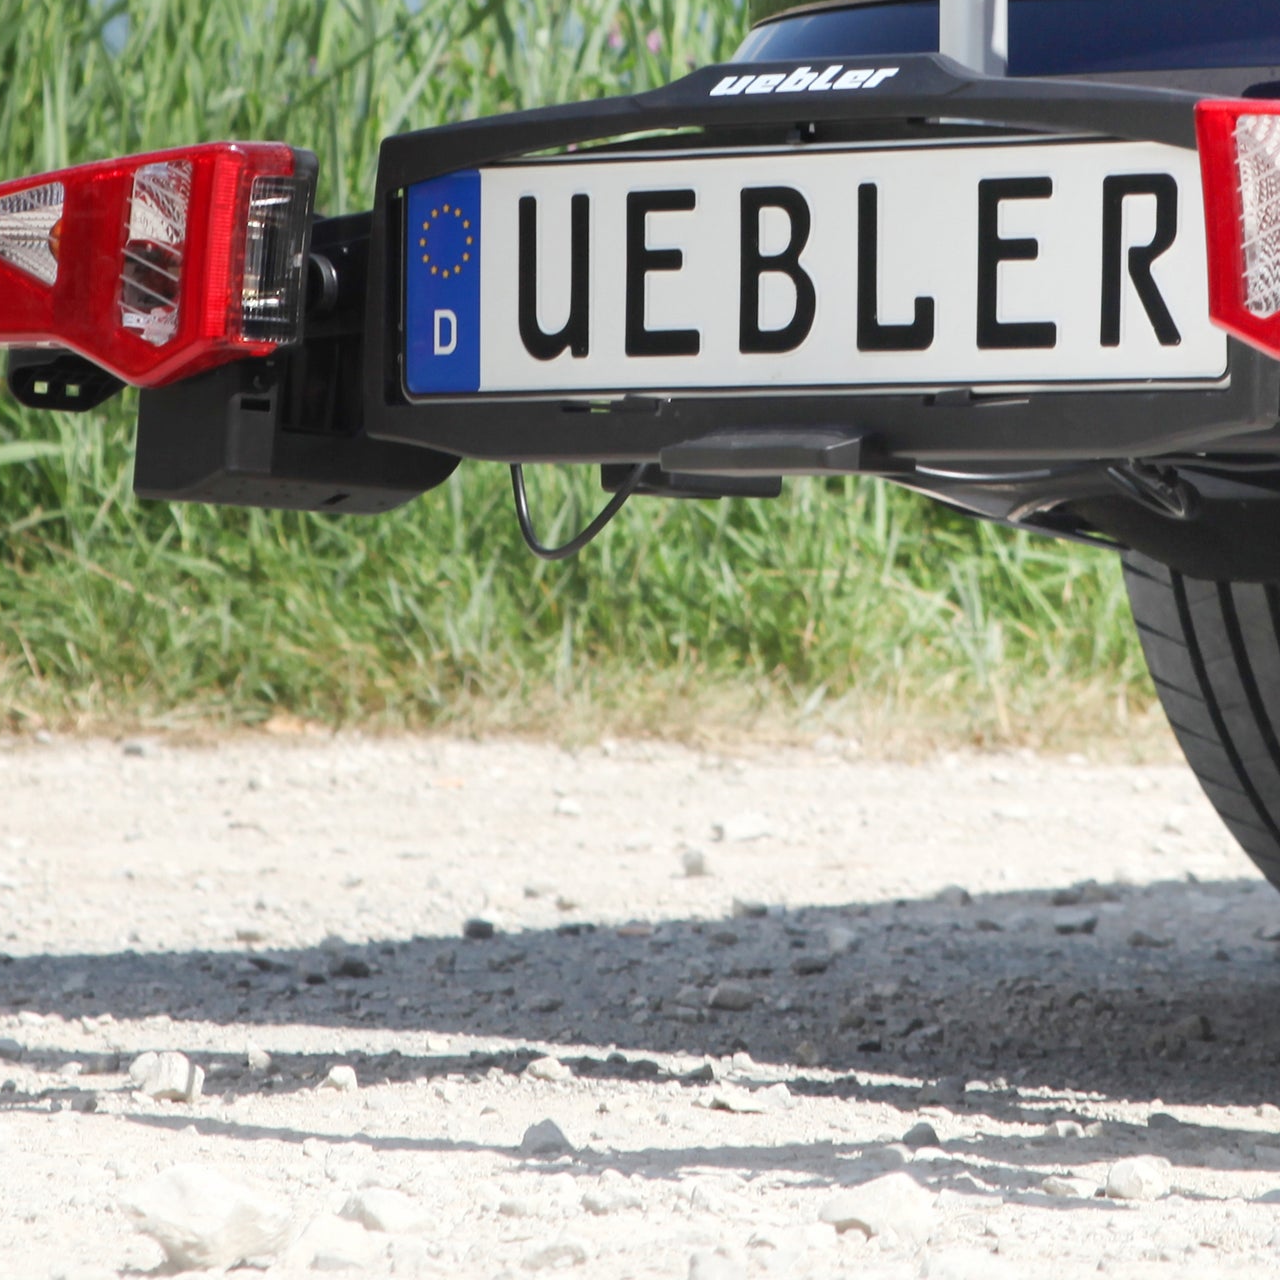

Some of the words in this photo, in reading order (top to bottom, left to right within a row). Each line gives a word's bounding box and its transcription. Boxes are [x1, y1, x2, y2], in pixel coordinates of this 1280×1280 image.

[709, 64, 900, 97] uebler
[517, 172, 1181, 361] UEBLER
[433, 308, 459, 356] D
